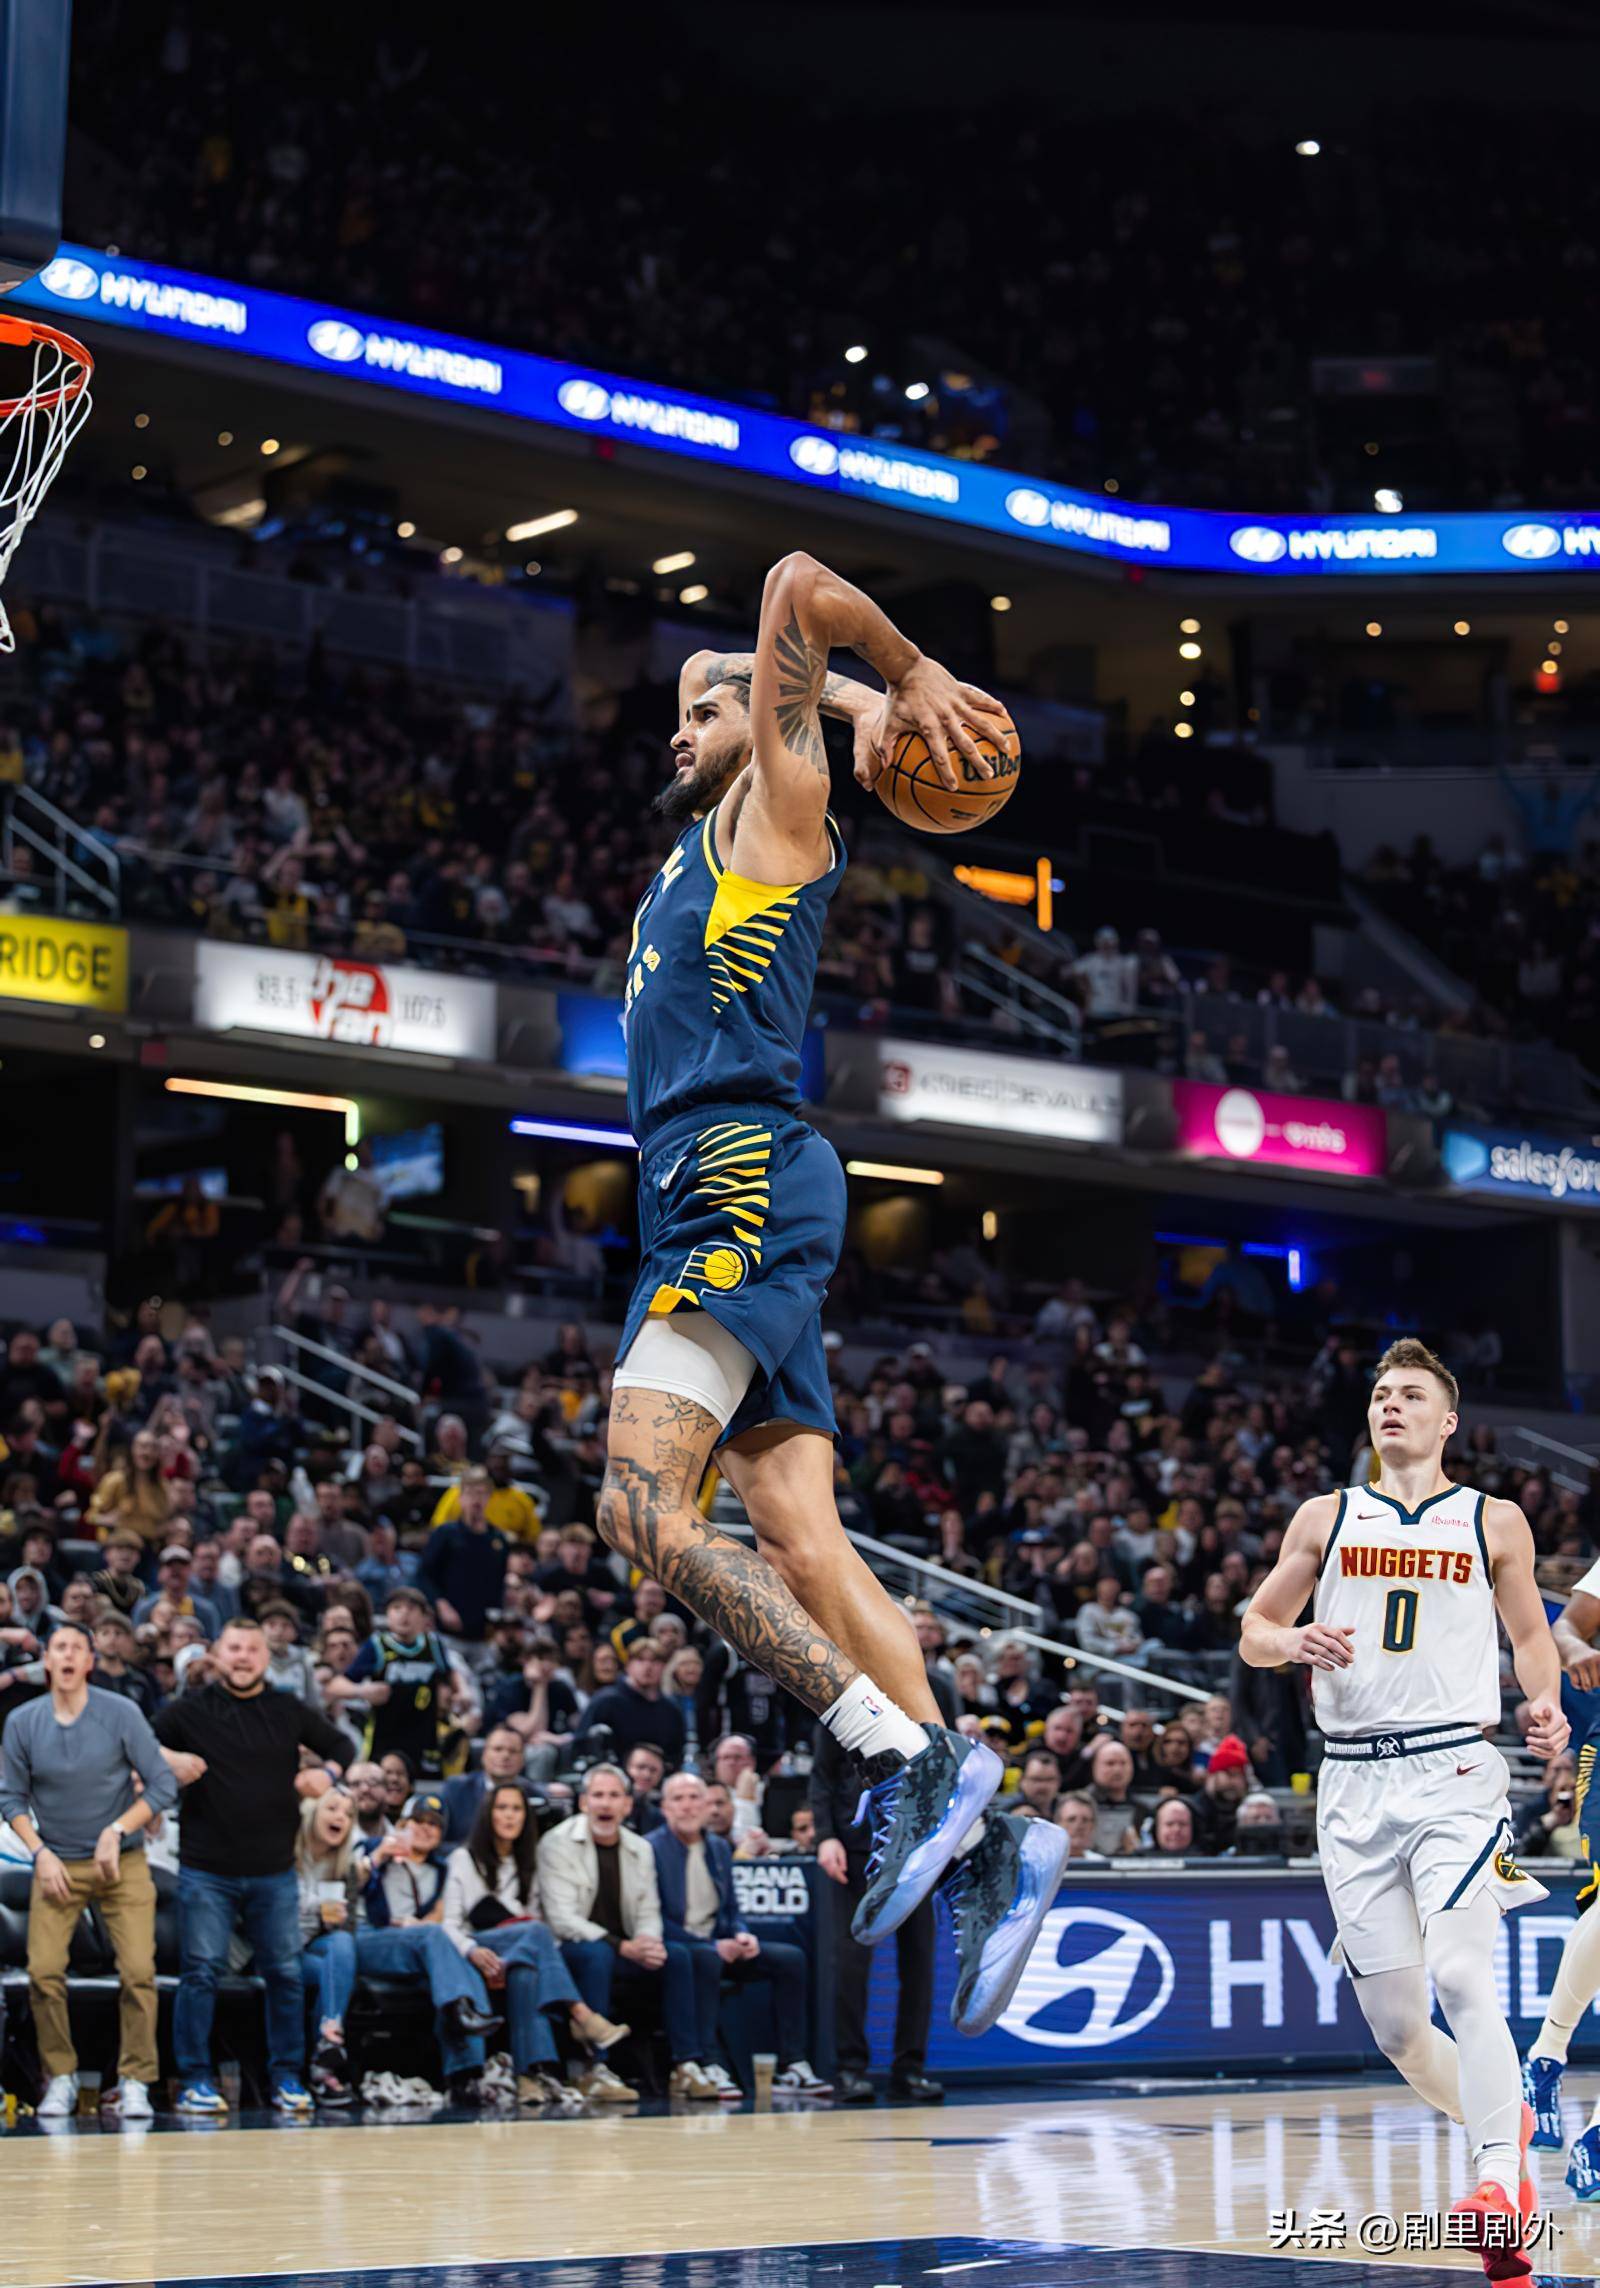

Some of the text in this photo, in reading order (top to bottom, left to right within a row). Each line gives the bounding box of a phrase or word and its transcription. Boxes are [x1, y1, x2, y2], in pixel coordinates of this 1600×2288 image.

[100, 269, 248, 335] HYUNDAI
[364, 333, 502, 393] HYUNDAI
[610, 393, 740, 450] HYUNDAI
[838, 449, 960, 504] HYUNDAI
[1052, 500, 1171, 552] HYUNDAI
[1288, 527, 1438, 560] HYUNDAI
[0, 931, 112, 992] RIDGE
[1339, 1545, 1474, 1585] NUGGETS
[1381, 1587, 1421, 1655] 0
